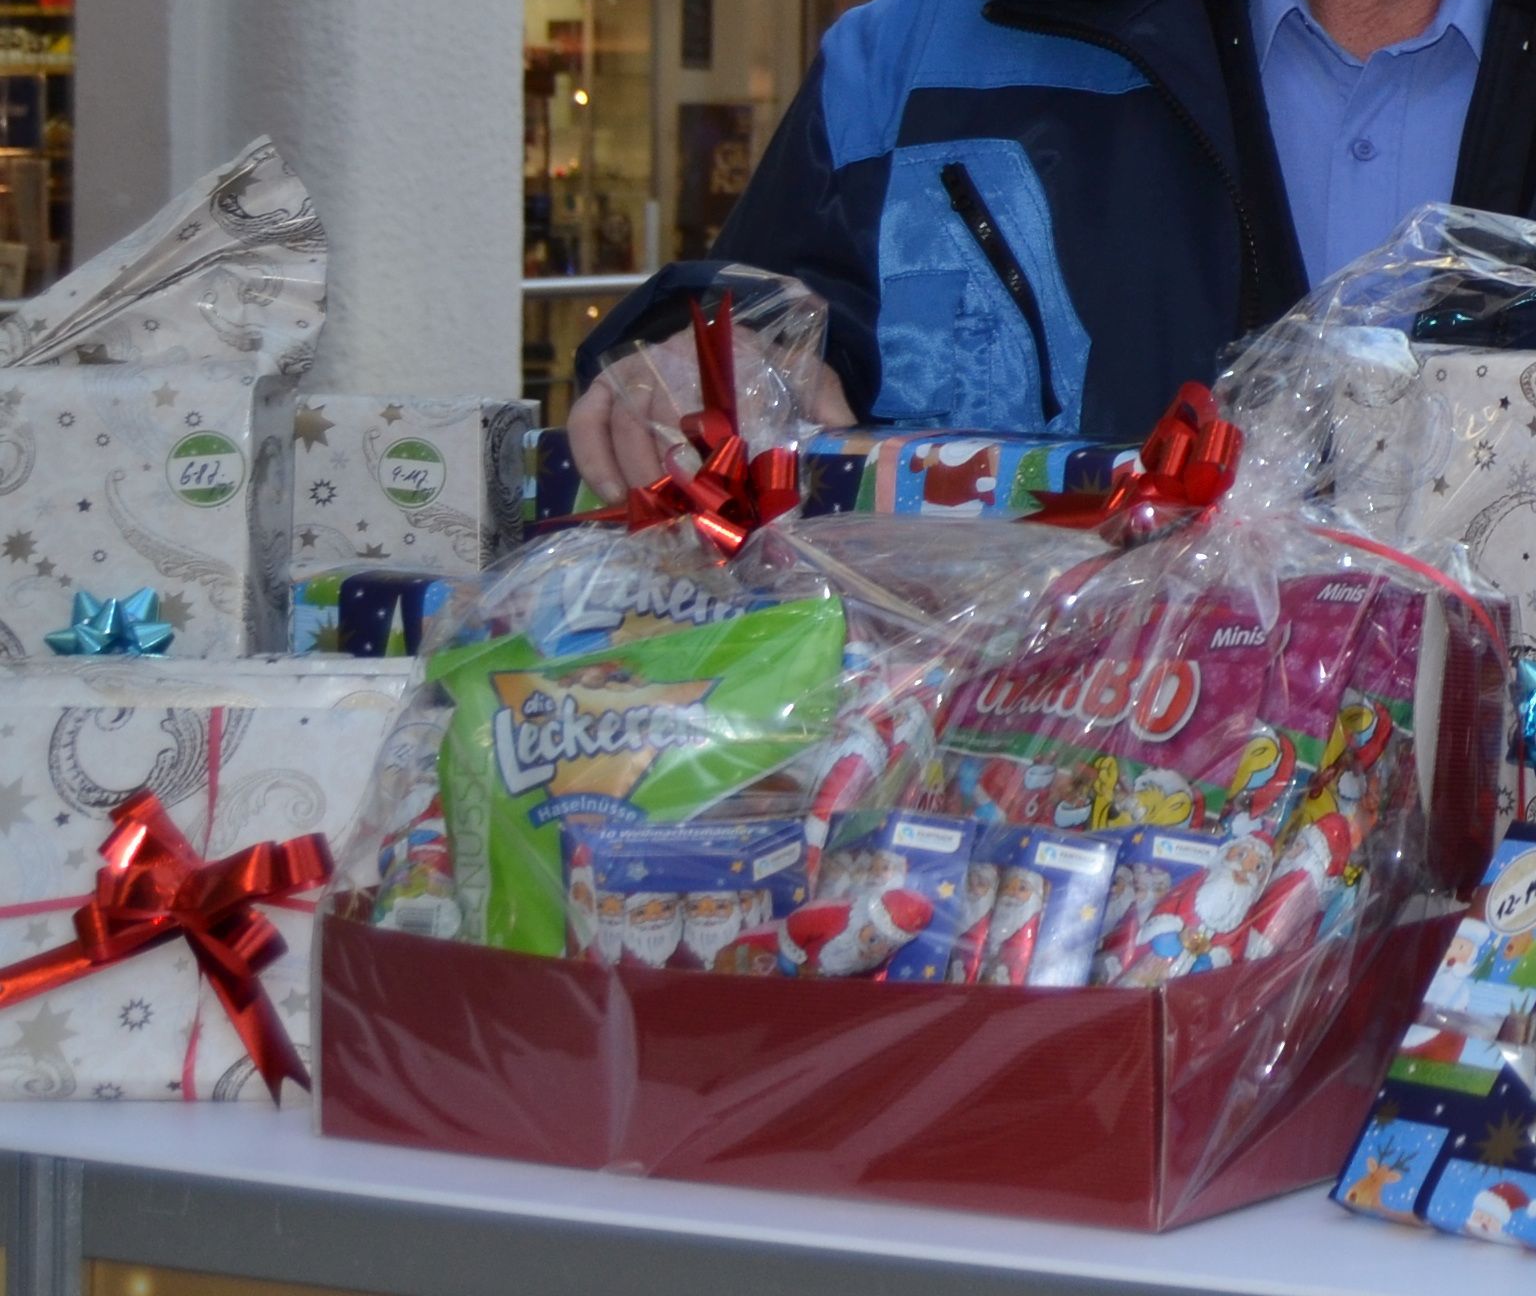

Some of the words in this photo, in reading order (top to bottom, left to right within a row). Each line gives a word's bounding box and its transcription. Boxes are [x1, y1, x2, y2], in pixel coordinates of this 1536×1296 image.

[1316, 583, 1368, 602] Minis
[1210, 623, 1267, 649] Minis
[494, 693, 714, 796] Leckeren
